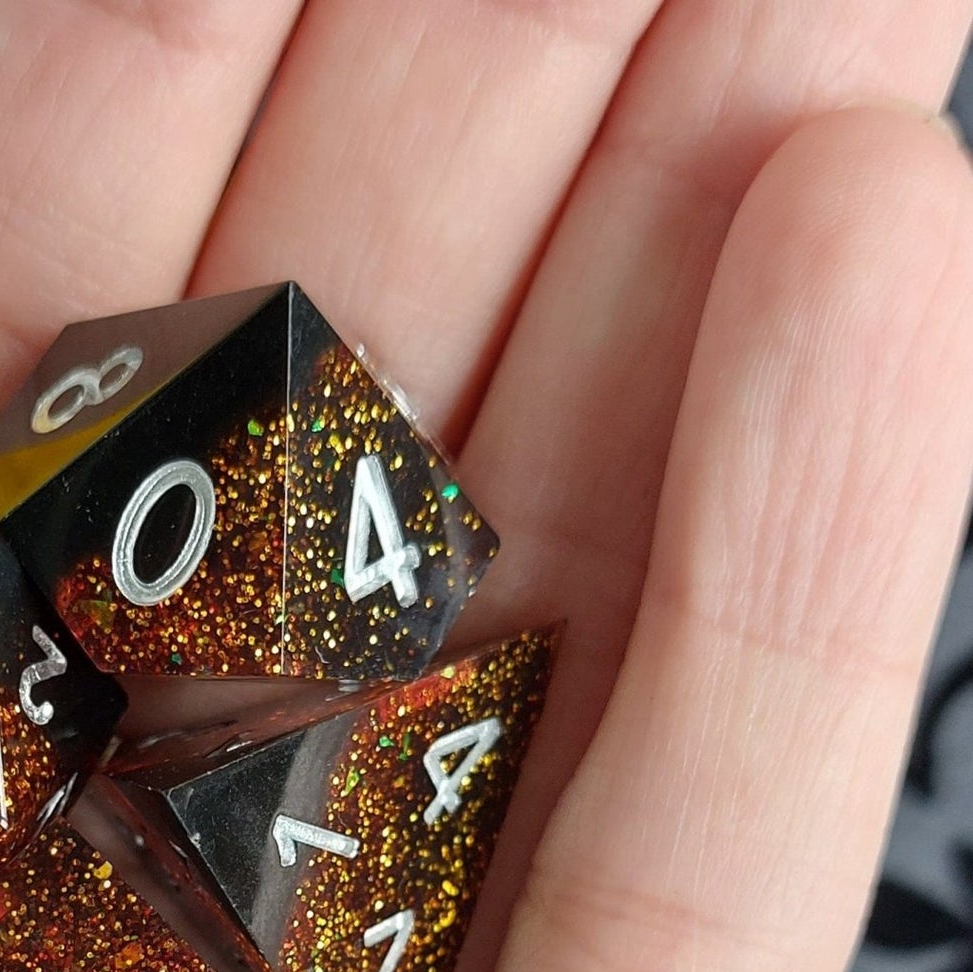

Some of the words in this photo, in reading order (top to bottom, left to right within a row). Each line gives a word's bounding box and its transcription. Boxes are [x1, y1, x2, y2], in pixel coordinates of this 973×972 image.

[31, 345, 144, 434] 8
[111, 457, 216, 606] 0
[344, 453, 421, 609] 4
[19, 624, 68, 726] 2
[423, 717, 502, 825] 4
[272, 814, 360, 868] 1
